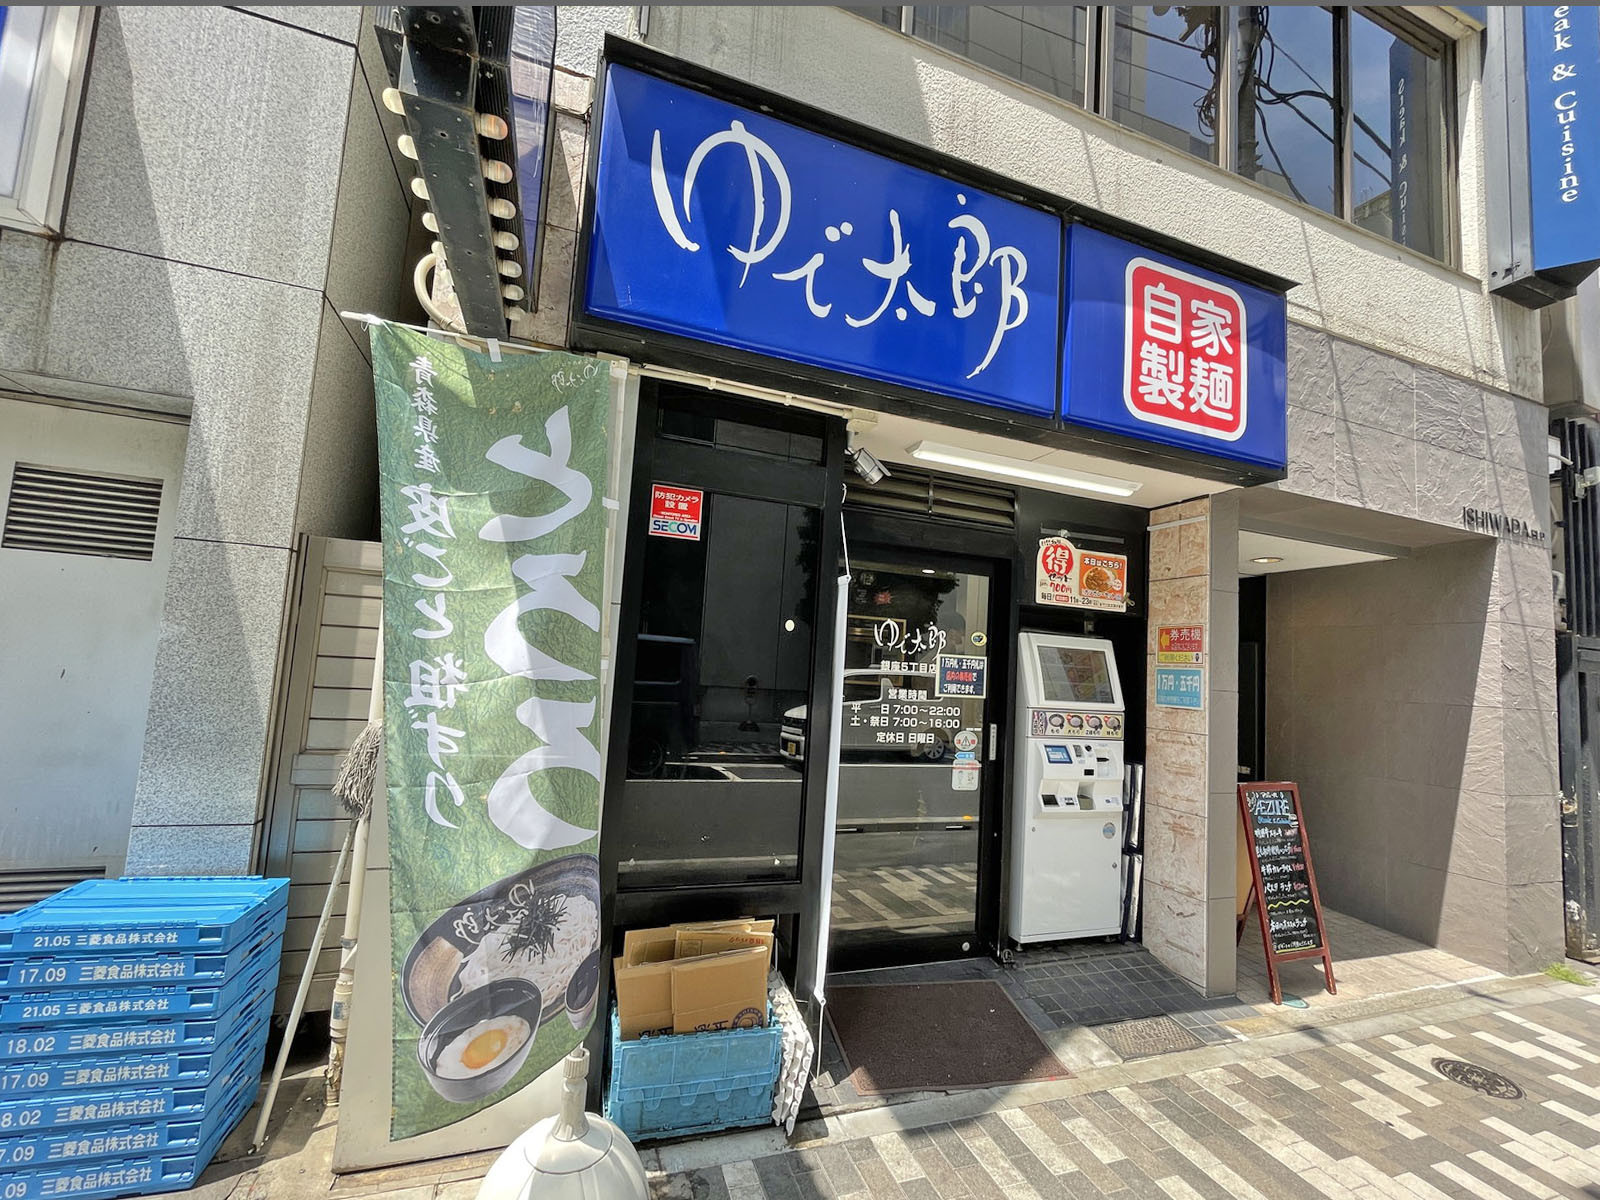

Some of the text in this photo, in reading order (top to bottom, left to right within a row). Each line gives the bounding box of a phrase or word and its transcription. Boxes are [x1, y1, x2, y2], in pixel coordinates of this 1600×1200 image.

[1552, 64, 1577, 82] &
[1554, 91, 1579, 202] Cuisine
[651, 119, 1029, 379] ゆで太郎
[1143, 282, 1234, 356] 自家
[655, 490, 699, 503] 防犯カメラ
[653, 520, 697, 535] SECOM
[1045, 547, 1069, 574] 得
[873, 618, 947, 661] ゆで太郎
[1170, 628, 1201, 640] 券売機
[888, 688, 928, 701] 営業時間
[876, 732, 935, 744] 定休日 日曜日
[34, 932, 179, 948] 21.05 三菱食品株式会社
[19, 962, 186, 983] 17.09 三菱食品株式会社
[23, 998, 169, 1018] 21.05 三菱食品株式会社
[7, 1029, 176, 1055] 18.02 三菱食品株式会社
[2, 1062, 170, 1090] 17.09 三菱食品株式会社
[55, 1098, 166, 1124] 三菱食品株式会社
[48, 1132, 159, 1160] 三菱食品株式会社
[40, 1167, 153, 1196] 三菱食品株式会社
